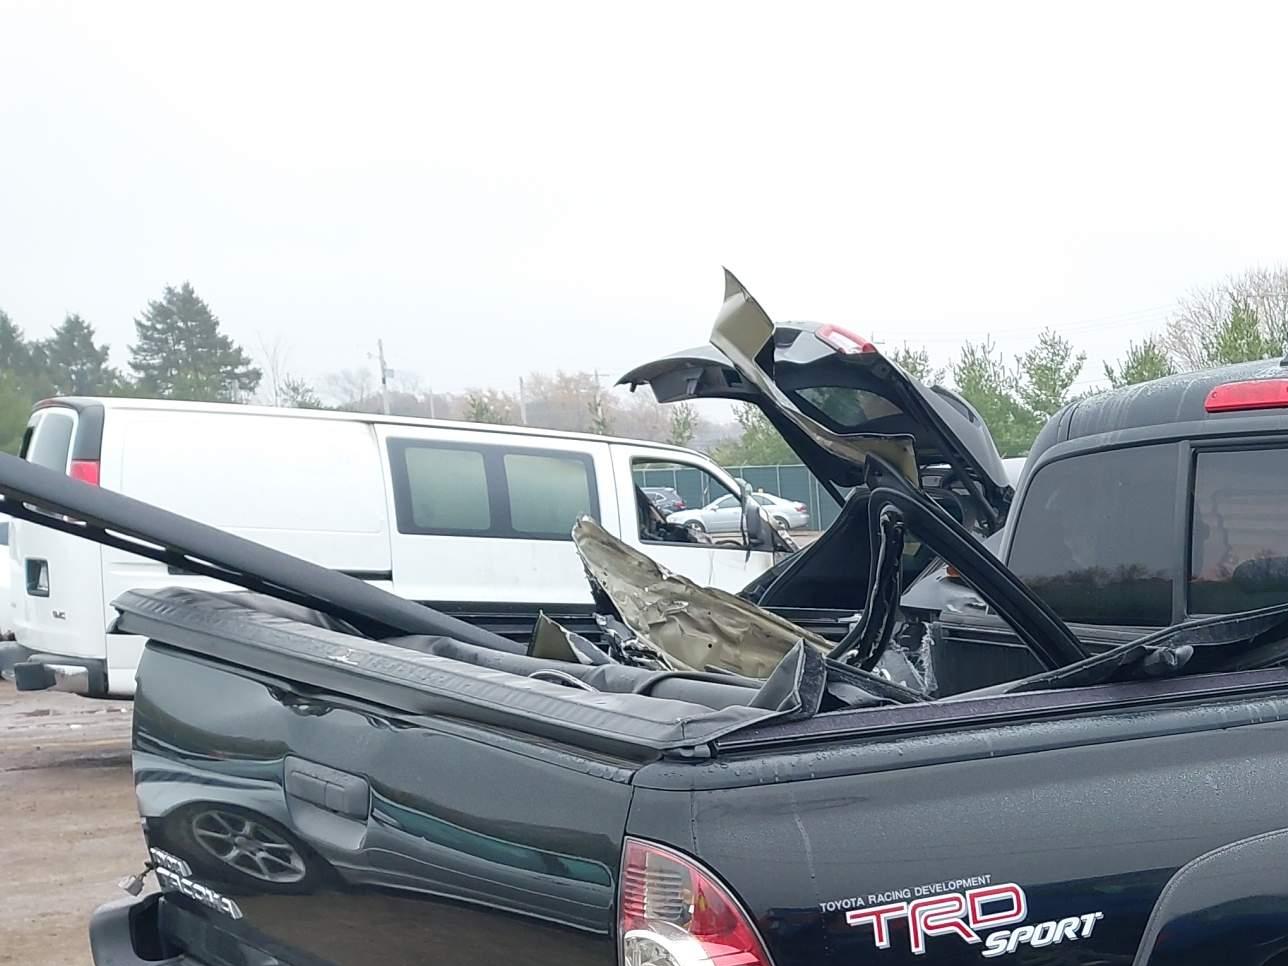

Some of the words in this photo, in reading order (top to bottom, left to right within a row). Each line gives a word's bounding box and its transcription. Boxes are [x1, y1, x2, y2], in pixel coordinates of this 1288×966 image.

[820, 897, 864, 912] TOYOTA
[867, 887, 911, 904] RACING
[914, 874, 992, 897] DEVELOPMENT
[846, 882, 1029, 954] TRD
[981, 912, 1104, 957] SPORT
